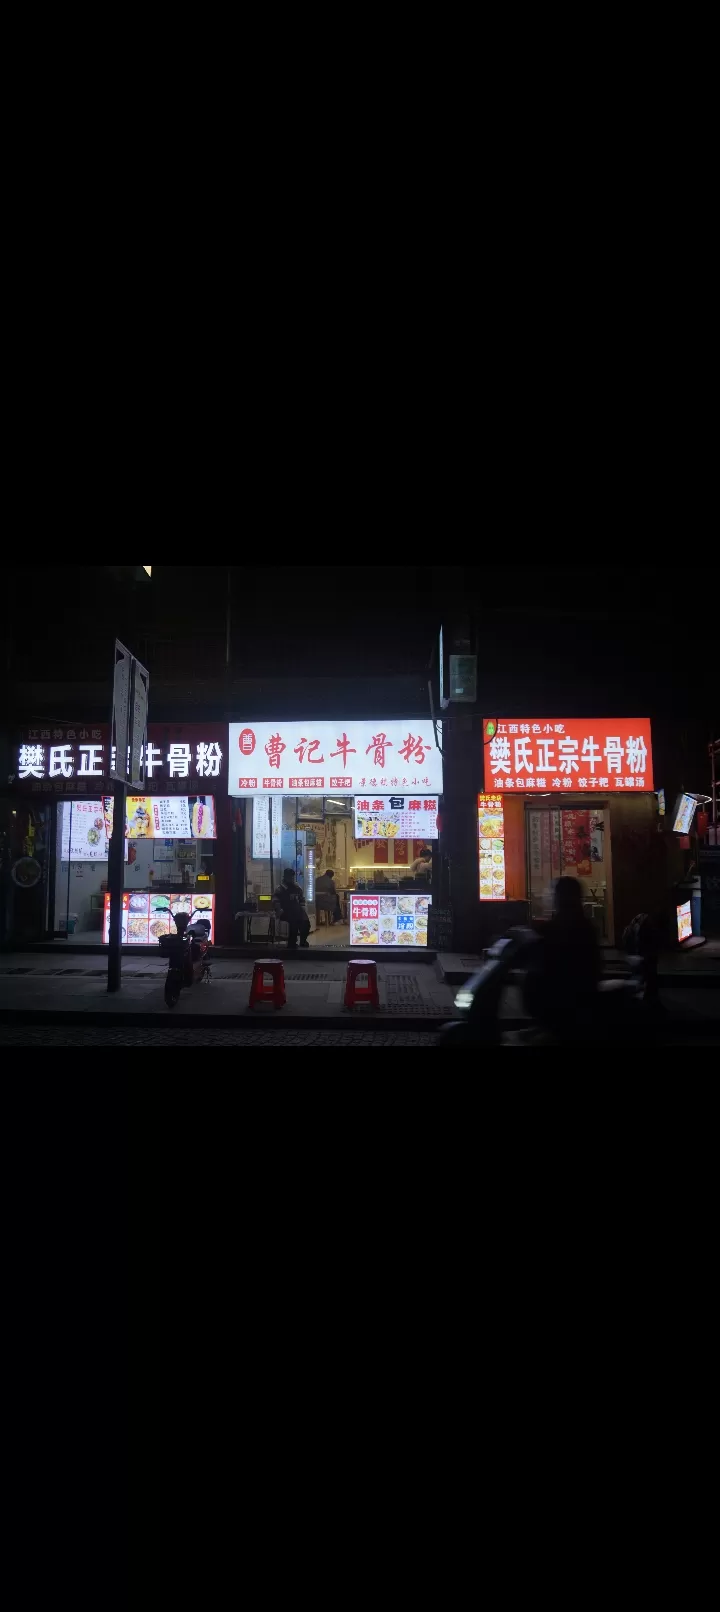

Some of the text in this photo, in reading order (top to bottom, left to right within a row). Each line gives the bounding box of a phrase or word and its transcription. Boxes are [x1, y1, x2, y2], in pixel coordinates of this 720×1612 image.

[497, 723, 566, 734] 江西特色小吃
[28, 729, 103, 740] 江西特色小吃
[264, 732, 432, 769] 曹记牛骨粉
[489, 736, 647, 774] 樊氏正宗牛骨粉
[18, 742, 223, 779] 樊氏正牛骨粉
[240, 778, 256, 787] 冷粉
[552, 777, 573, 788] 冷粉
[353, 907, 377, 917] 牛骨粉
